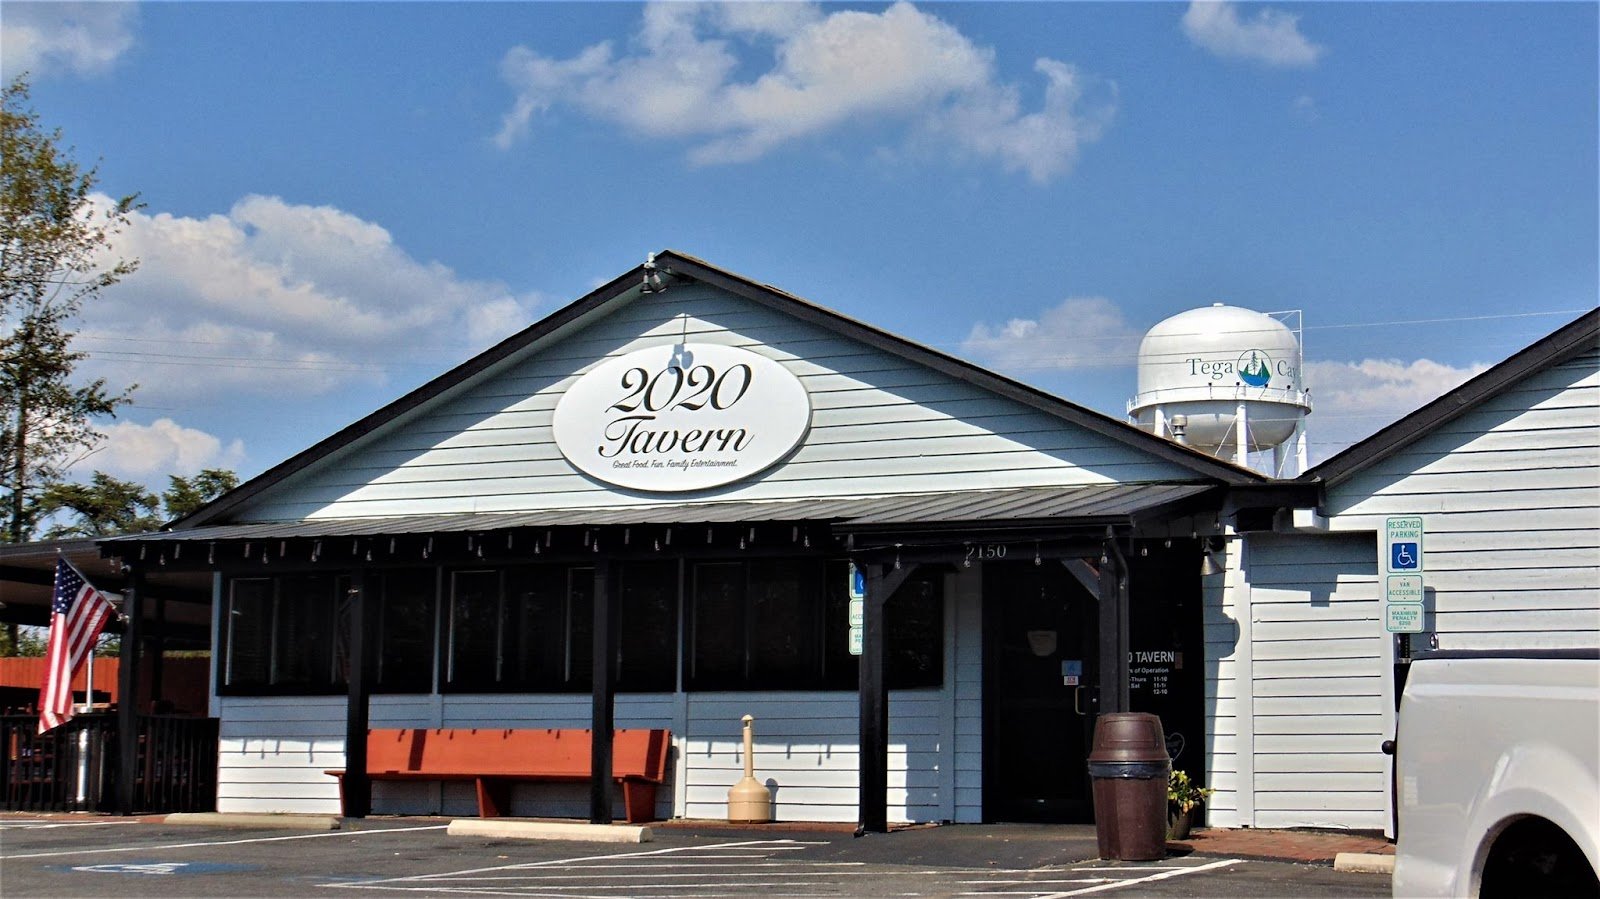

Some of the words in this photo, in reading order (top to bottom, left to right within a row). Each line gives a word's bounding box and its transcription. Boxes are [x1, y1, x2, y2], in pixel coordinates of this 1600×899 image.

[1186, 358, 1233, 380] Tega
[605, 364, 752, 413] 2020
[597, 415, 754, 457] Tavern
[612, 460, 631, 469] Great
[666, 459, 689, 471] Family
[690, 459, 738, 468] Entertainment.
[1388, 520, 1421, 529] RESERVED
[1391, 530, 1419, 538] PARKING
[1388, 588, 1421, 596] ACCESSIBLE
[1135, 651, 1175, 663] TAVERN
